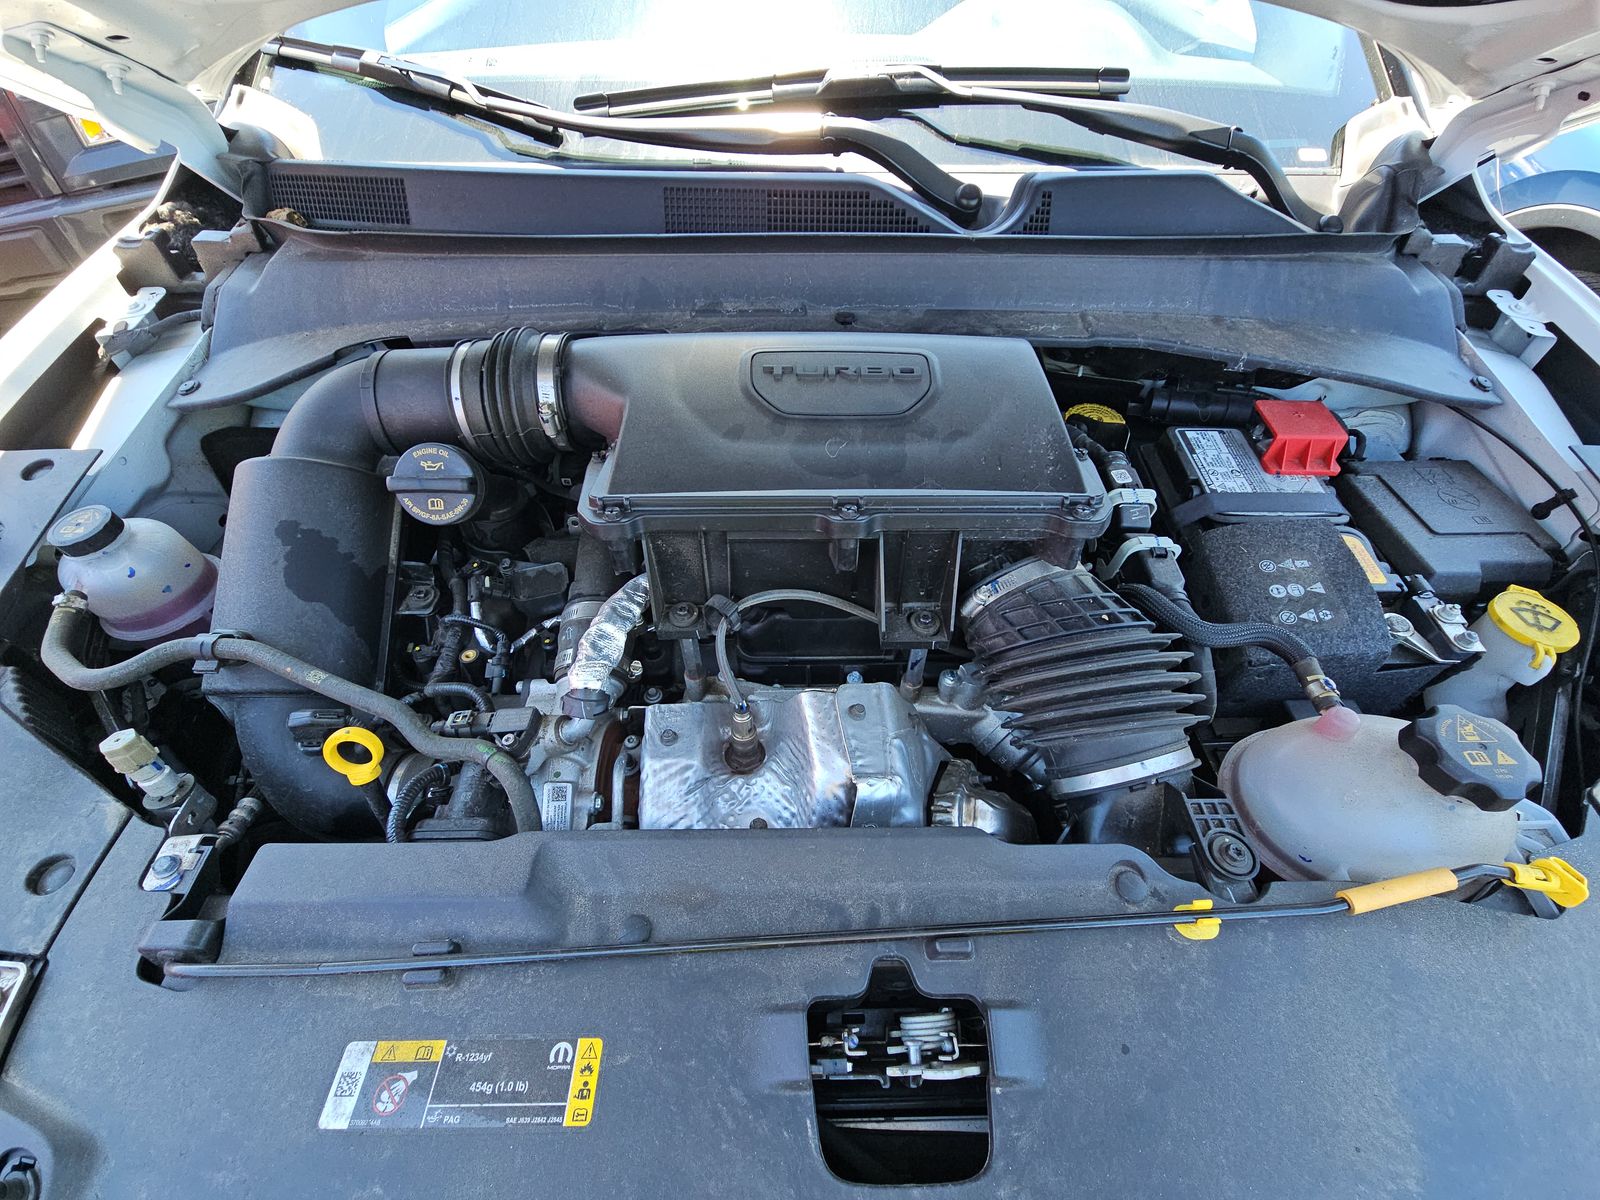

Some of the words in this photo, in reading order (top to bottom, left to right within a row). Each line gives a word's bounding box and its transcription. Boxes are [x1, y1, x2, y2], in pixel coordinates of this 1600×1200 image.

[762, 364, 922, 381] TURBO
[412, 447, 437, 458] ENGINE
[438, 449, 449, 458] OIL
[402, 497, 413, 509] API
[455, 1052, 493, 1063] R-1234yf
[469, 1081, 493, 1094] 454g
[495, 1081, 513, 1094] (1.0
[514, 1080, 529, 1094] lb)
[443, 1115, 460, 1125] PAG
